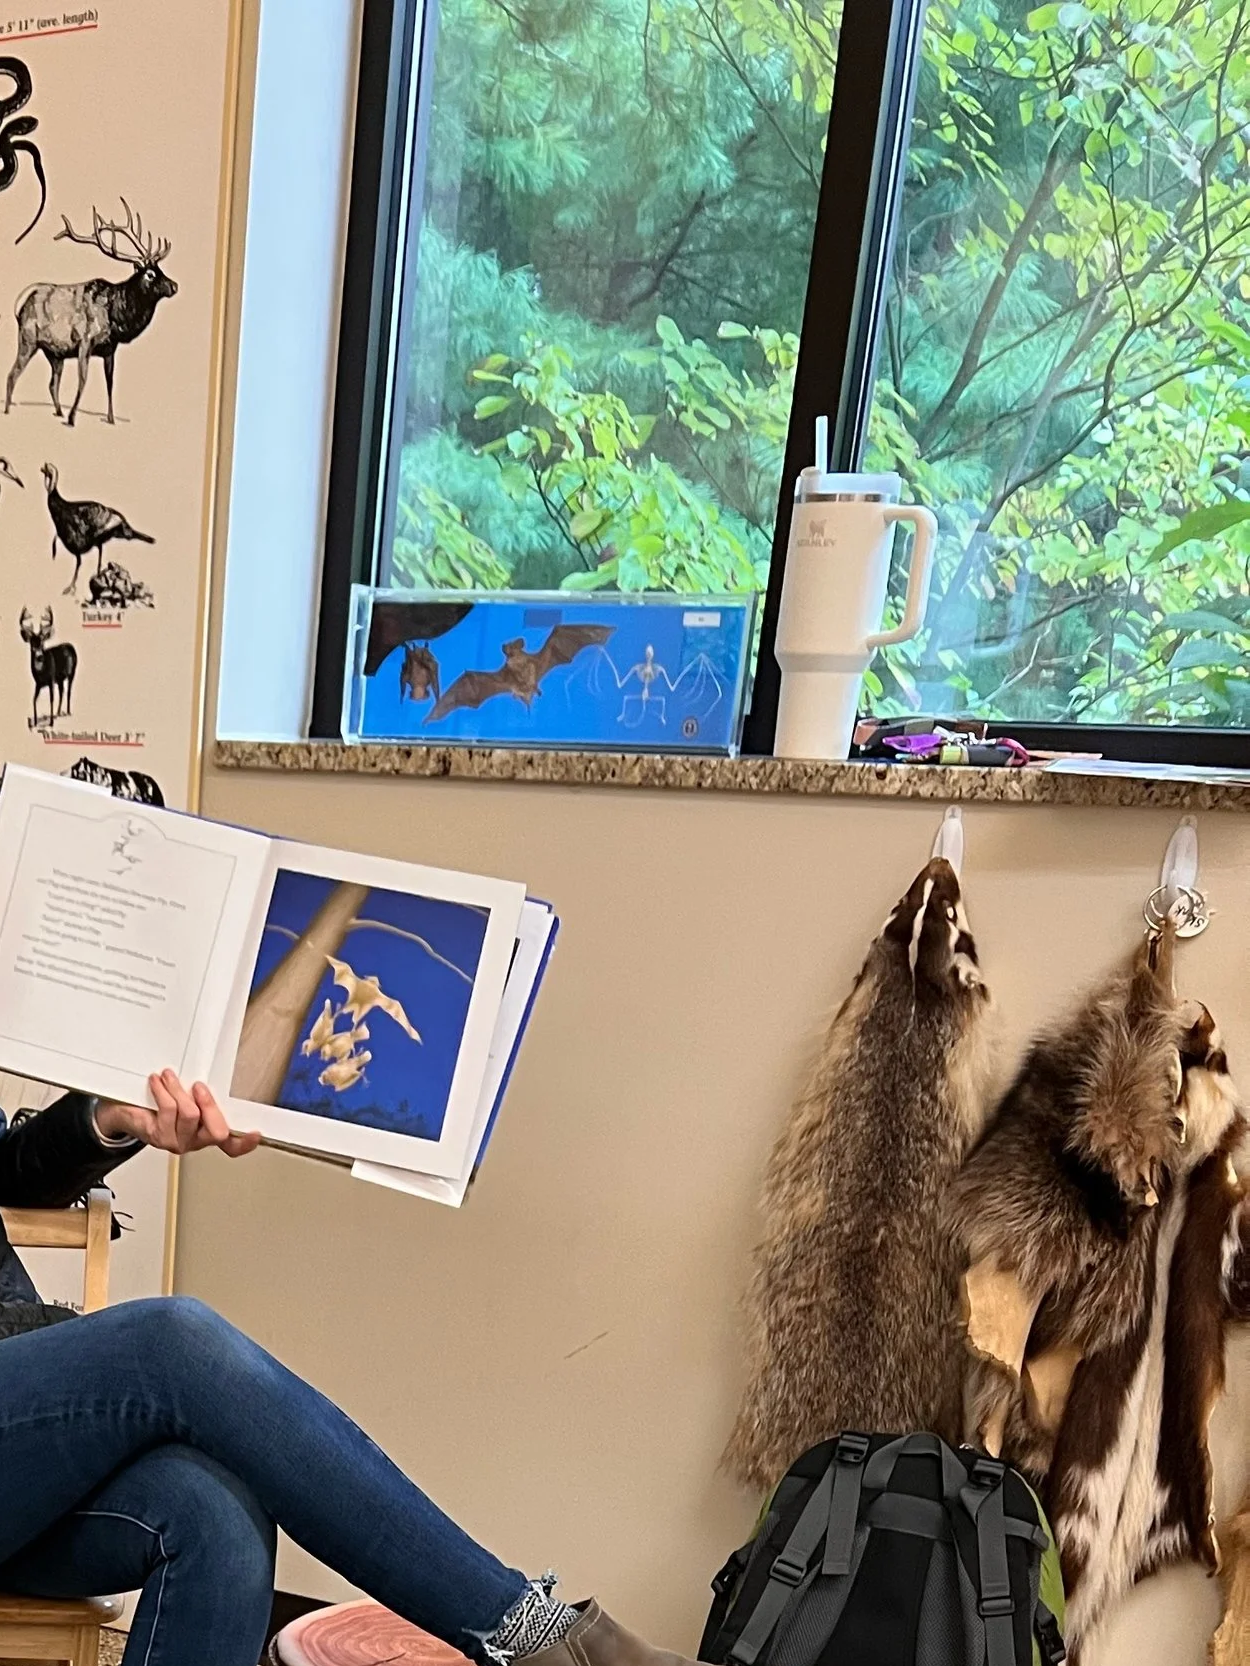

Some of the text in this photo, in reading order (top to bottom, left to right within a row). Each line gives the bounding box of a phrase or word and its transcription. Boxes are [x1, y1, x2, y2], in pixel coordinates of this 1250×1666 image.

[6, 20, 16, 33] 5'
[18, 18, 35, 32] 11"
[36, 17, 61, 31] (ave.
[62, 8, 99, 26] length)
[82, 610, 113, 624] Turkey
